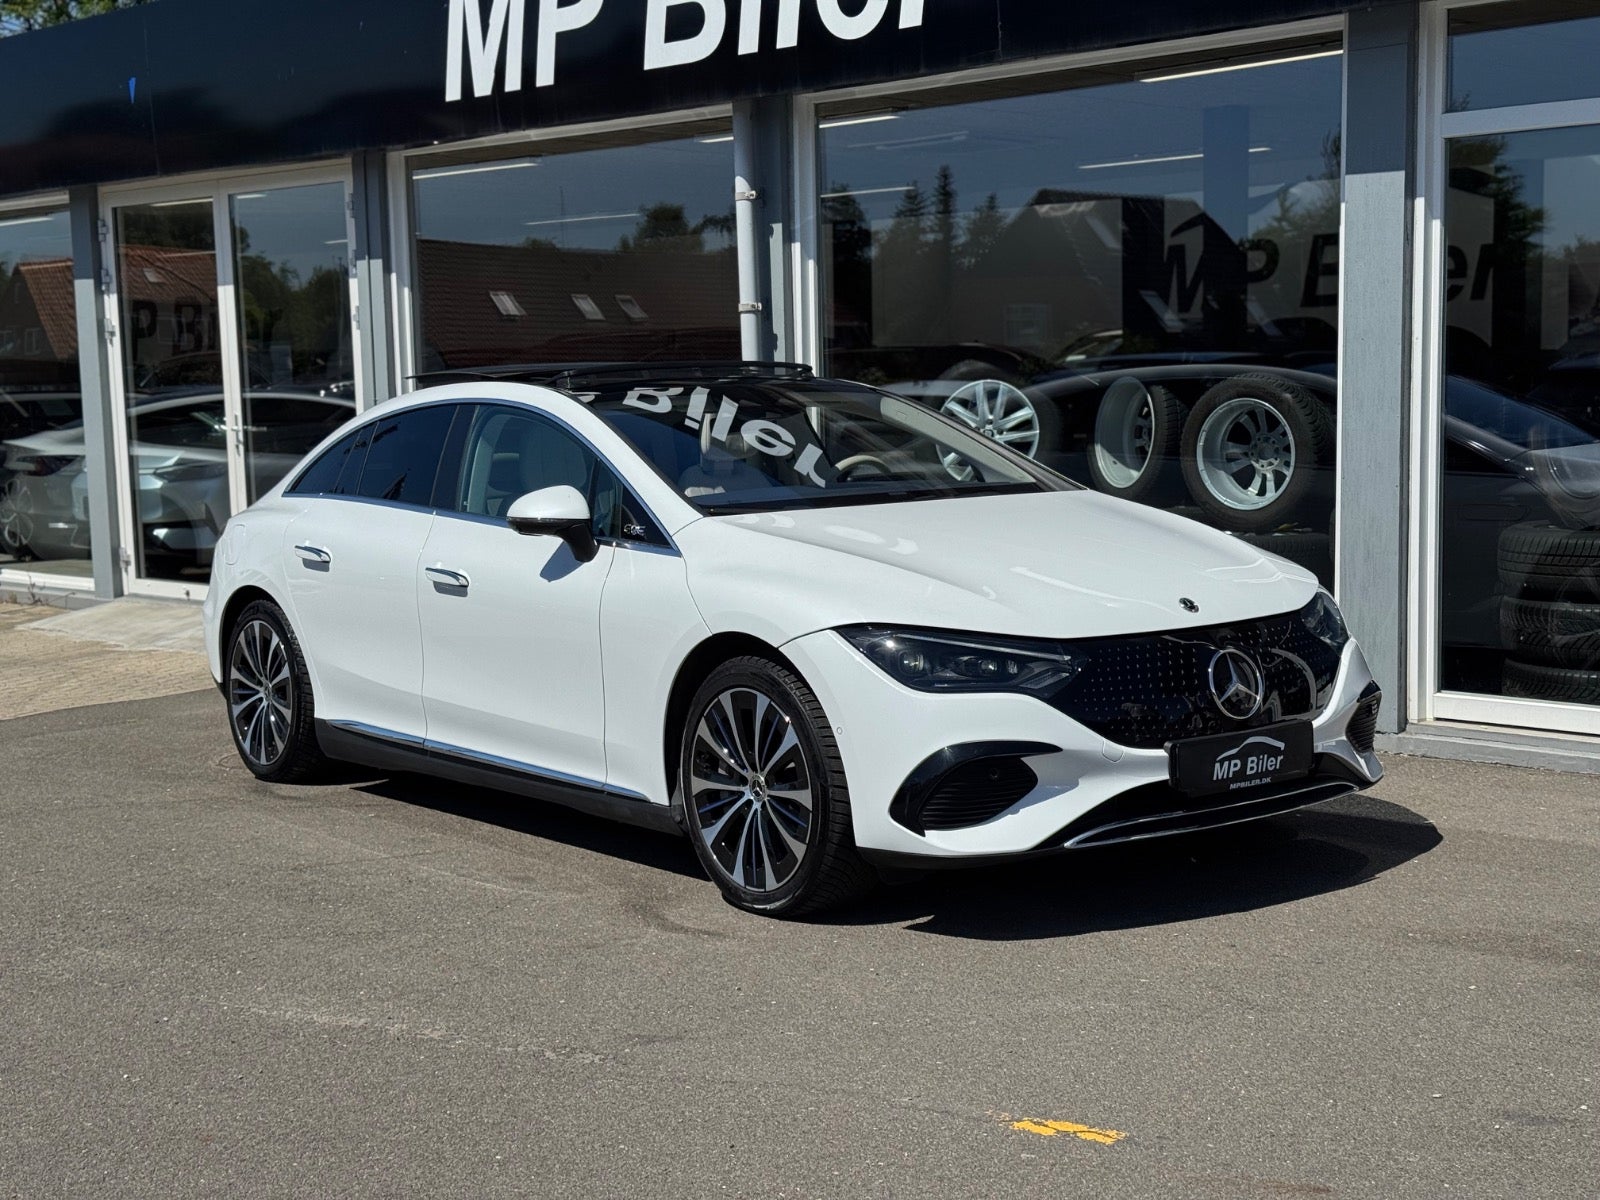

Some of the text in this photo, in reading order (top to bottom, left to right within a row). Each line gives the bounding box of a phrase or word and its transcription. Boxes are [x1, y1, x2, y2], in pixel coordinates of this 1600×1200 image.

[445, 0, 604, 102] MP
[1213, 754, 1284, 781] MP Biler
[1229, 777, 1272, 790] MPBILER.DK
